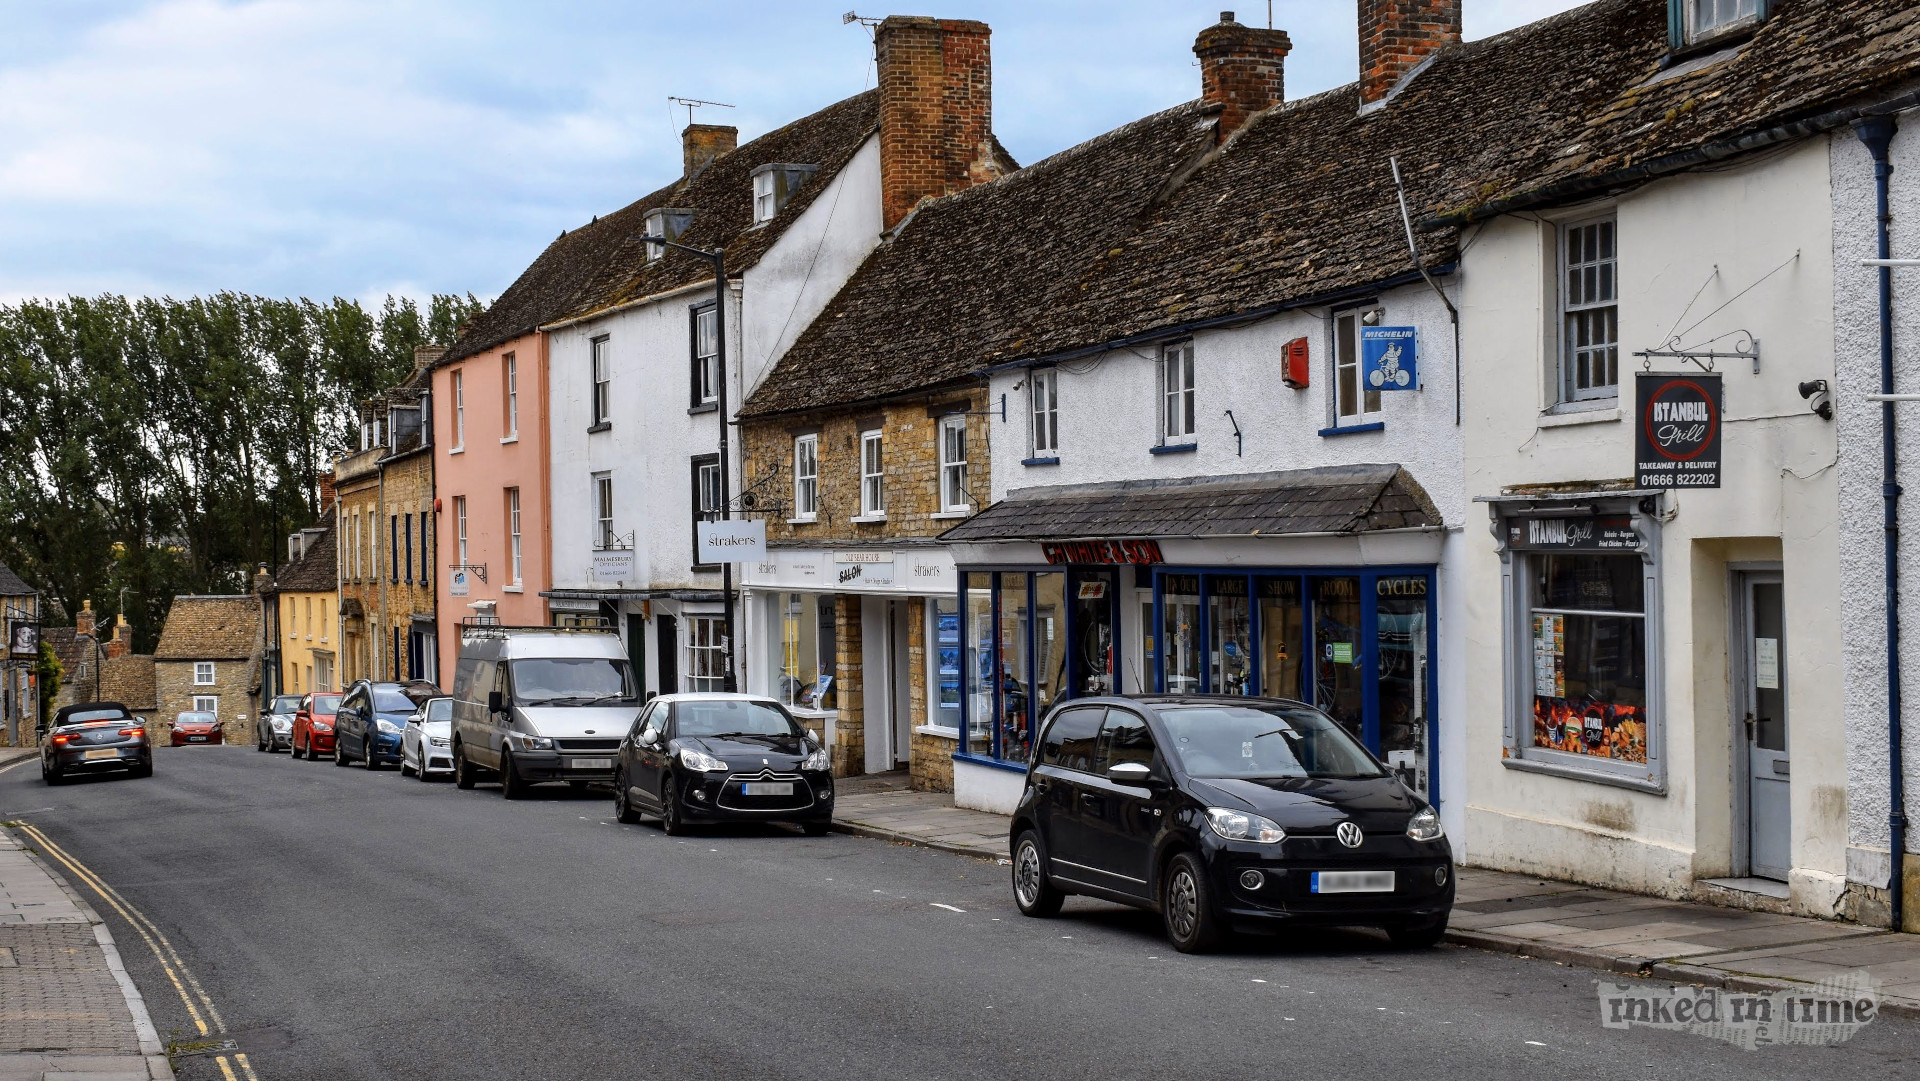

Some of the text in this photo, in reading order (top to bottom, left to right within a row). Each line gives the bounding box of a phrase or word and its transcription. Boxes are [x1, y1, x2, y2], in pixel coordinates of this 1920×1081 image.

[1654, 402, 1708, 422] ISTANBUL
[1658, 424, 1706, 446] Grill
[1639, 462, 1676, 470] TAKEAWAY
[1685, 461, 1717, 469] DELIVERY
[1641, 474, 1715, 486] 01666 822202
[708, 533, 756, 547] strakers
[1529, 520, 1567, 544] ISTANBUL
[1566, 520, 1593, 547] Grill
[1041, 540, 1165, 565] CH WHITE & SON
[839, 563, 863, 584] SALON
[914, 557, 940, 577] strakers
[1217, 579, 1244, 594] LARGE
[1268, 580, 1295, 595] SHOW
[1322, 579, 1353, 596] ROOM
[1377, 579, 1427, 595] CYCLES
